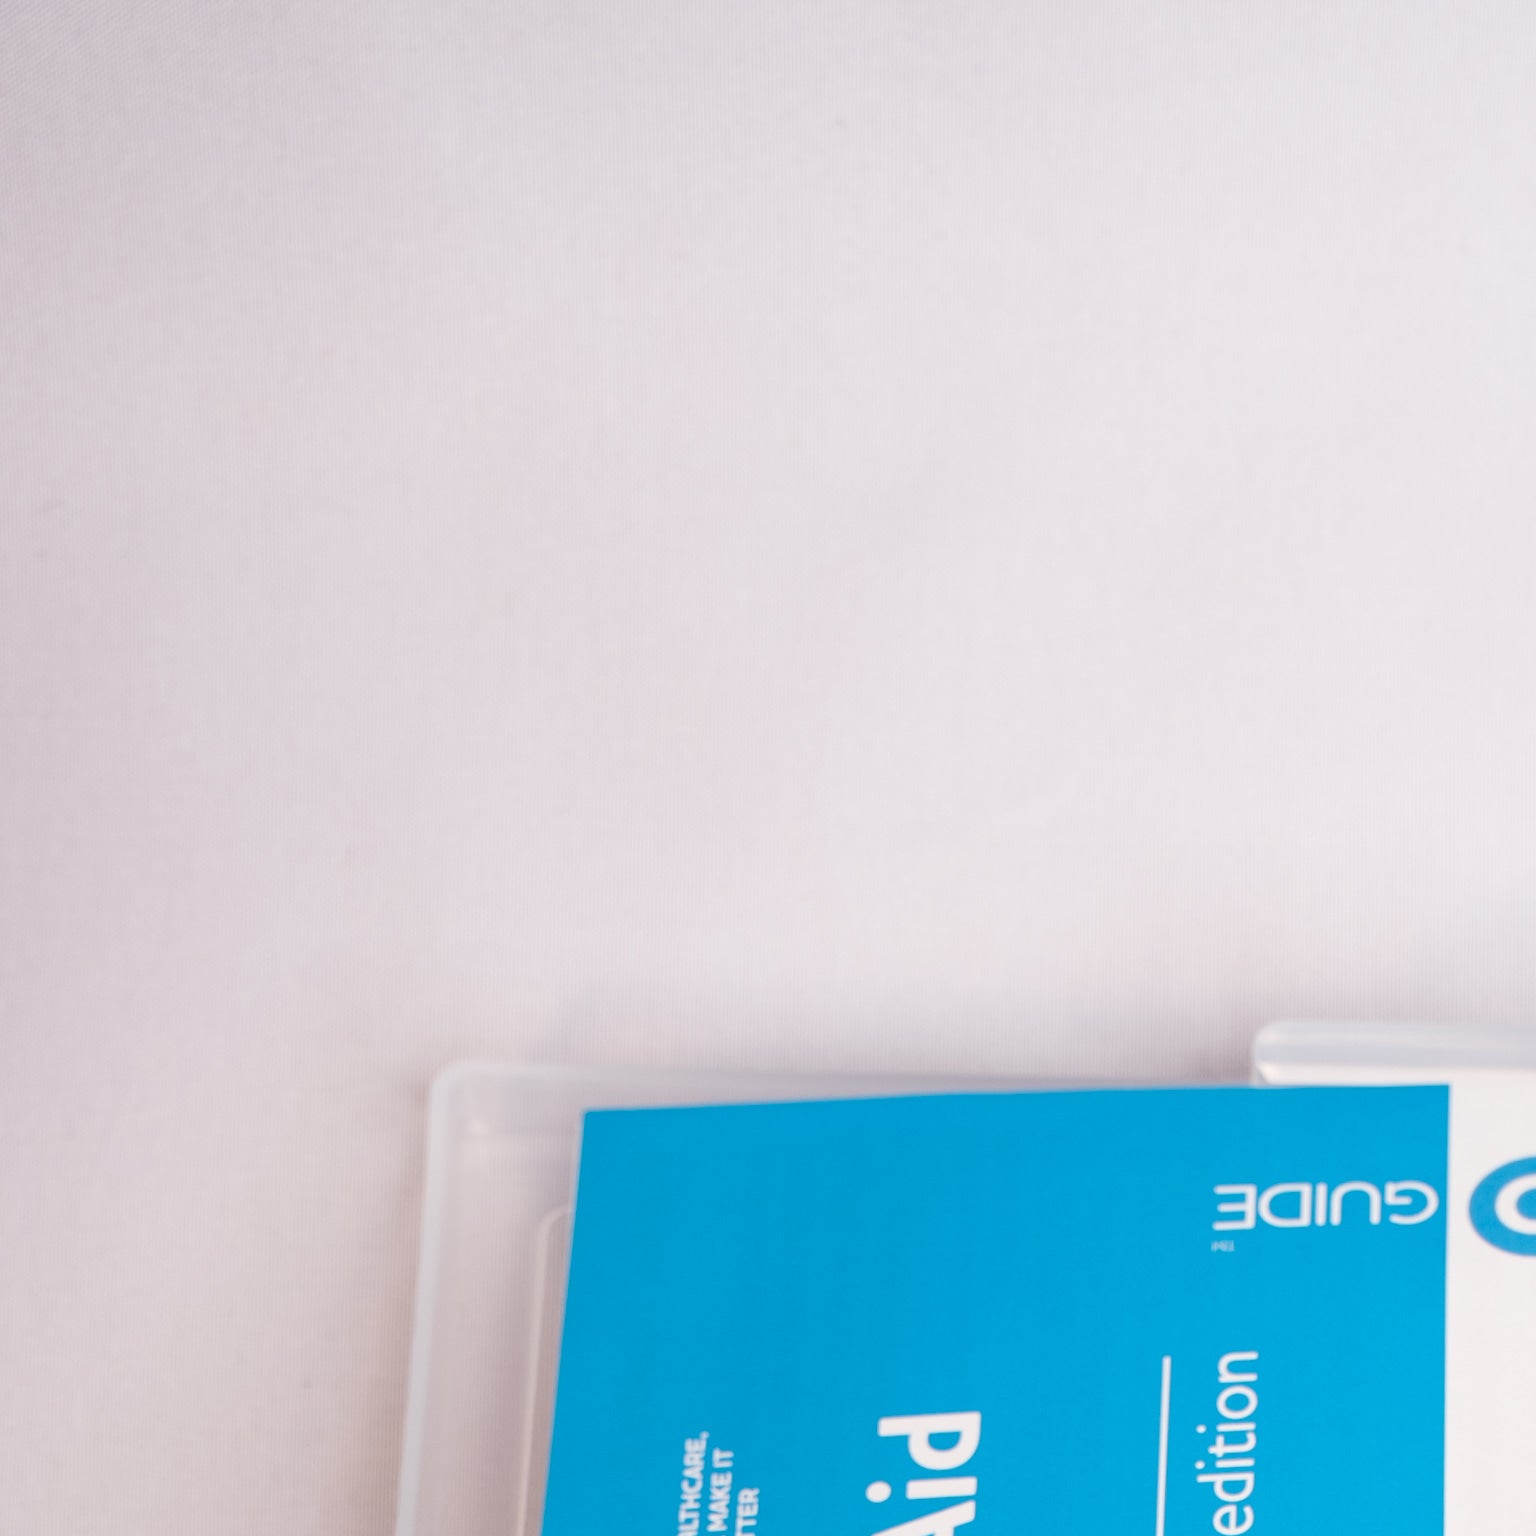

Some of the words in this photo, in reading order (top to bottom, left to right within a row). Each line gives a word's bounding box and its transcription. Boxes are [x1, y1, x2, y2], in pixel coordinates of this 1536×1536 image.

[1212, 1180, 1439, 1231] GUIDE
[714, 1448, 733, 1468] IT
[707, 1474, 730, 1532] MAKE
